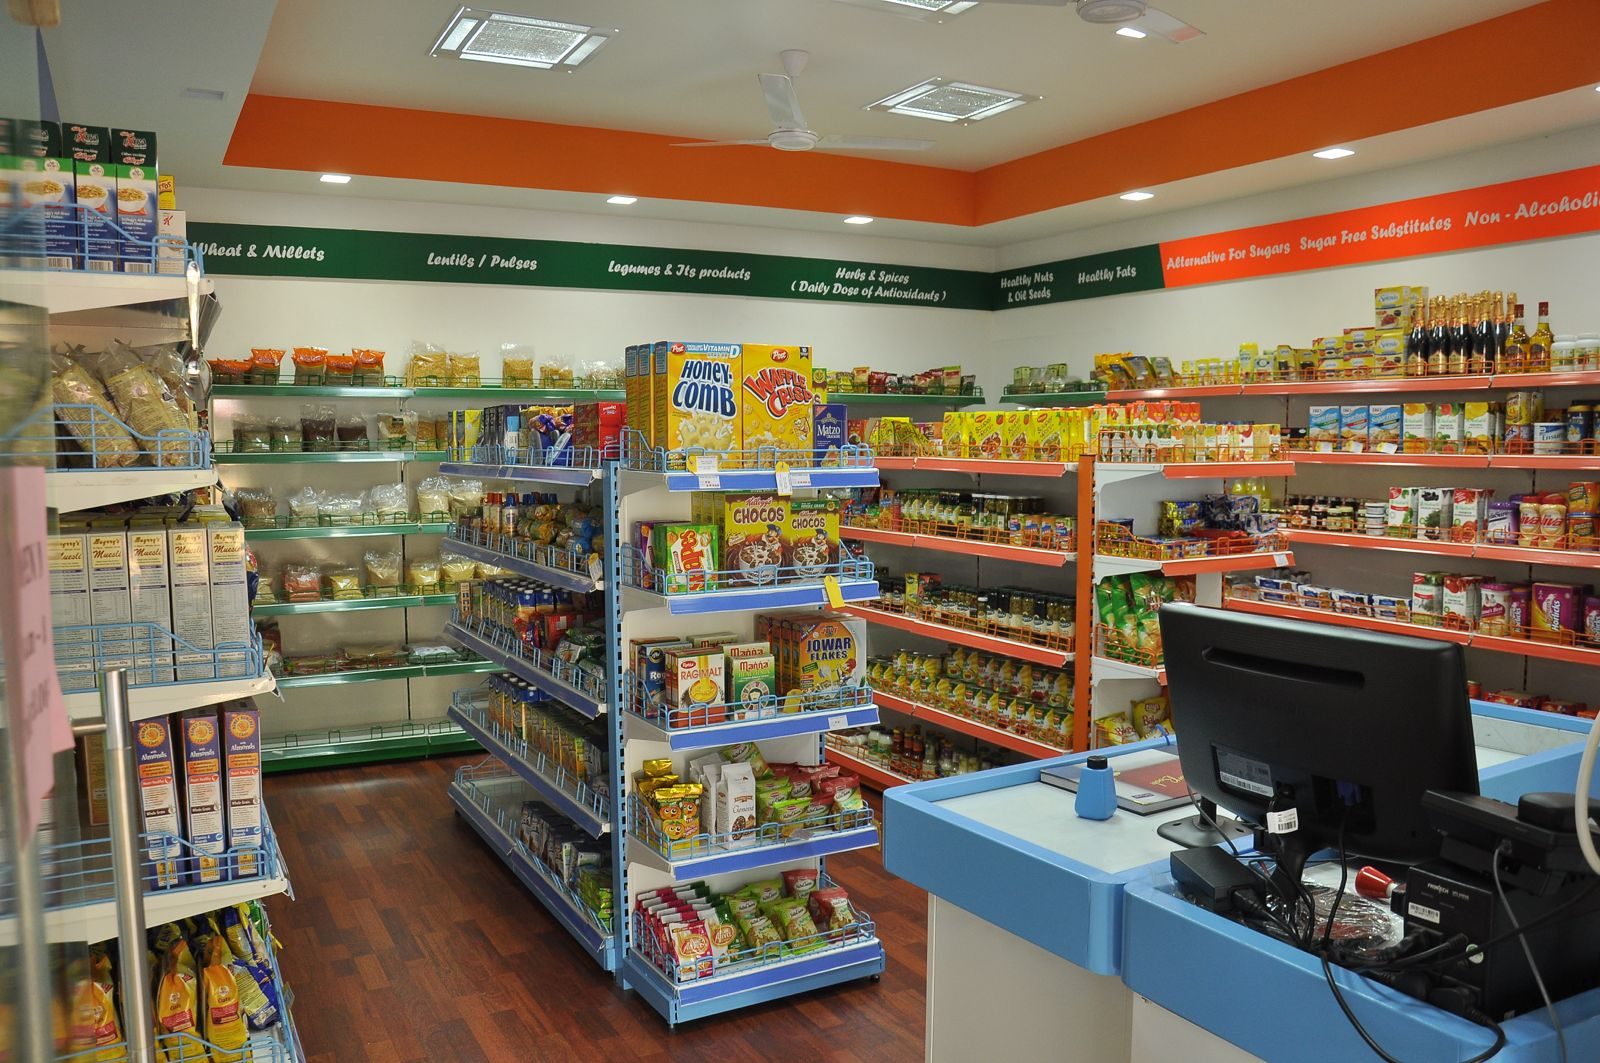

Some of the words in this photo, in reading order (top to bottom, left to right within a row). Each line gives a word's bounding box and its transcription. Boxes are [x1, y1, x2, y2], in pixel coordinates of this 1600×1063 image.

[1464, 210, 1500, 228] Non
[1514, 190, 1600, 219] Alcoholi
[1300, 235, 1338, 252] Sugar
[1340, 228, 1368, 244] Free
[1370, 215, 1452, 240] Substitutes
[192, 242, 242, 258] Wheat
[247, 244, 258, 258] &
[262, 244, 326, 262] Millets
[1166, 250, 1226, 270] Alternative
[1228, 248, 1246, 260] For
[1249, 241, 1291, 260] Sugars
[427, 252, 474, 268] Lentils
[478, 254, 488, 268] /
[490, 254, 538, 270] Pulses
[608, 260, 661, 277] Legumes
[664, 262, 674, 276] &
[676, 264, 696, 278] Its
[699, 266, 752, 281] products
[836, 267, 866, 282] Herbs
[868, 270, 876, 282] &
[878, 270, 910, 284] Spices
[1078, 268, 1114, 284] Healthy
[1116, 265, 1137, 280] Fats
[1000, 275, 1032, 290] Healthy
[1034, 272, 1054, 284] Nuts
[798, 280, 830, 296] Daily
[832, 282, 860, 296] Dose
[862, 284, 874, 300] of
[874, 285, 940, 302] Antioxidants
[1007, 292, 1014, 303] &
[1014, 290, 1027, 302] Oil
[1028, 286, 1052, 301] Seeds
[672, 344, 684, 353] Post
[729, 345, 740, 359] D
[772, 350, 788, 360] Post
[680, 360, 733, 385] HONEY-
[744, 368, 807, 401] WAFFLE
[672, 381, 736, 418] COMB
[768, 386, 814, 418] CRISP
[816, 424, 841, 437] Matzo
[745, 496, 773, 506] Kellogg's
[733, 507, 785, 523] CHOCOS
[792, 517, 825, 529] CHOCOS
[93, 550, 122, 558] Muesli
[134, 548, 162, 557] Muesli
[175, 545, 201, 554] Muesli
[214, 544, 241, 553] Muesli
[1551, 600, 1561, 632] Horlicks
[730, 648, 764, 657] Manna
[806, 637, 851, 653] JOWAR
[810, 650, 848, 661] FLAKES
[702, 666, 722, 678] MALT
[740, 660, 768, 671] Manna
[190, 749, 215, 758] Almonds
[231, 743, 256, 751] Almonds
[142, 752, 167, 761] Almonds
